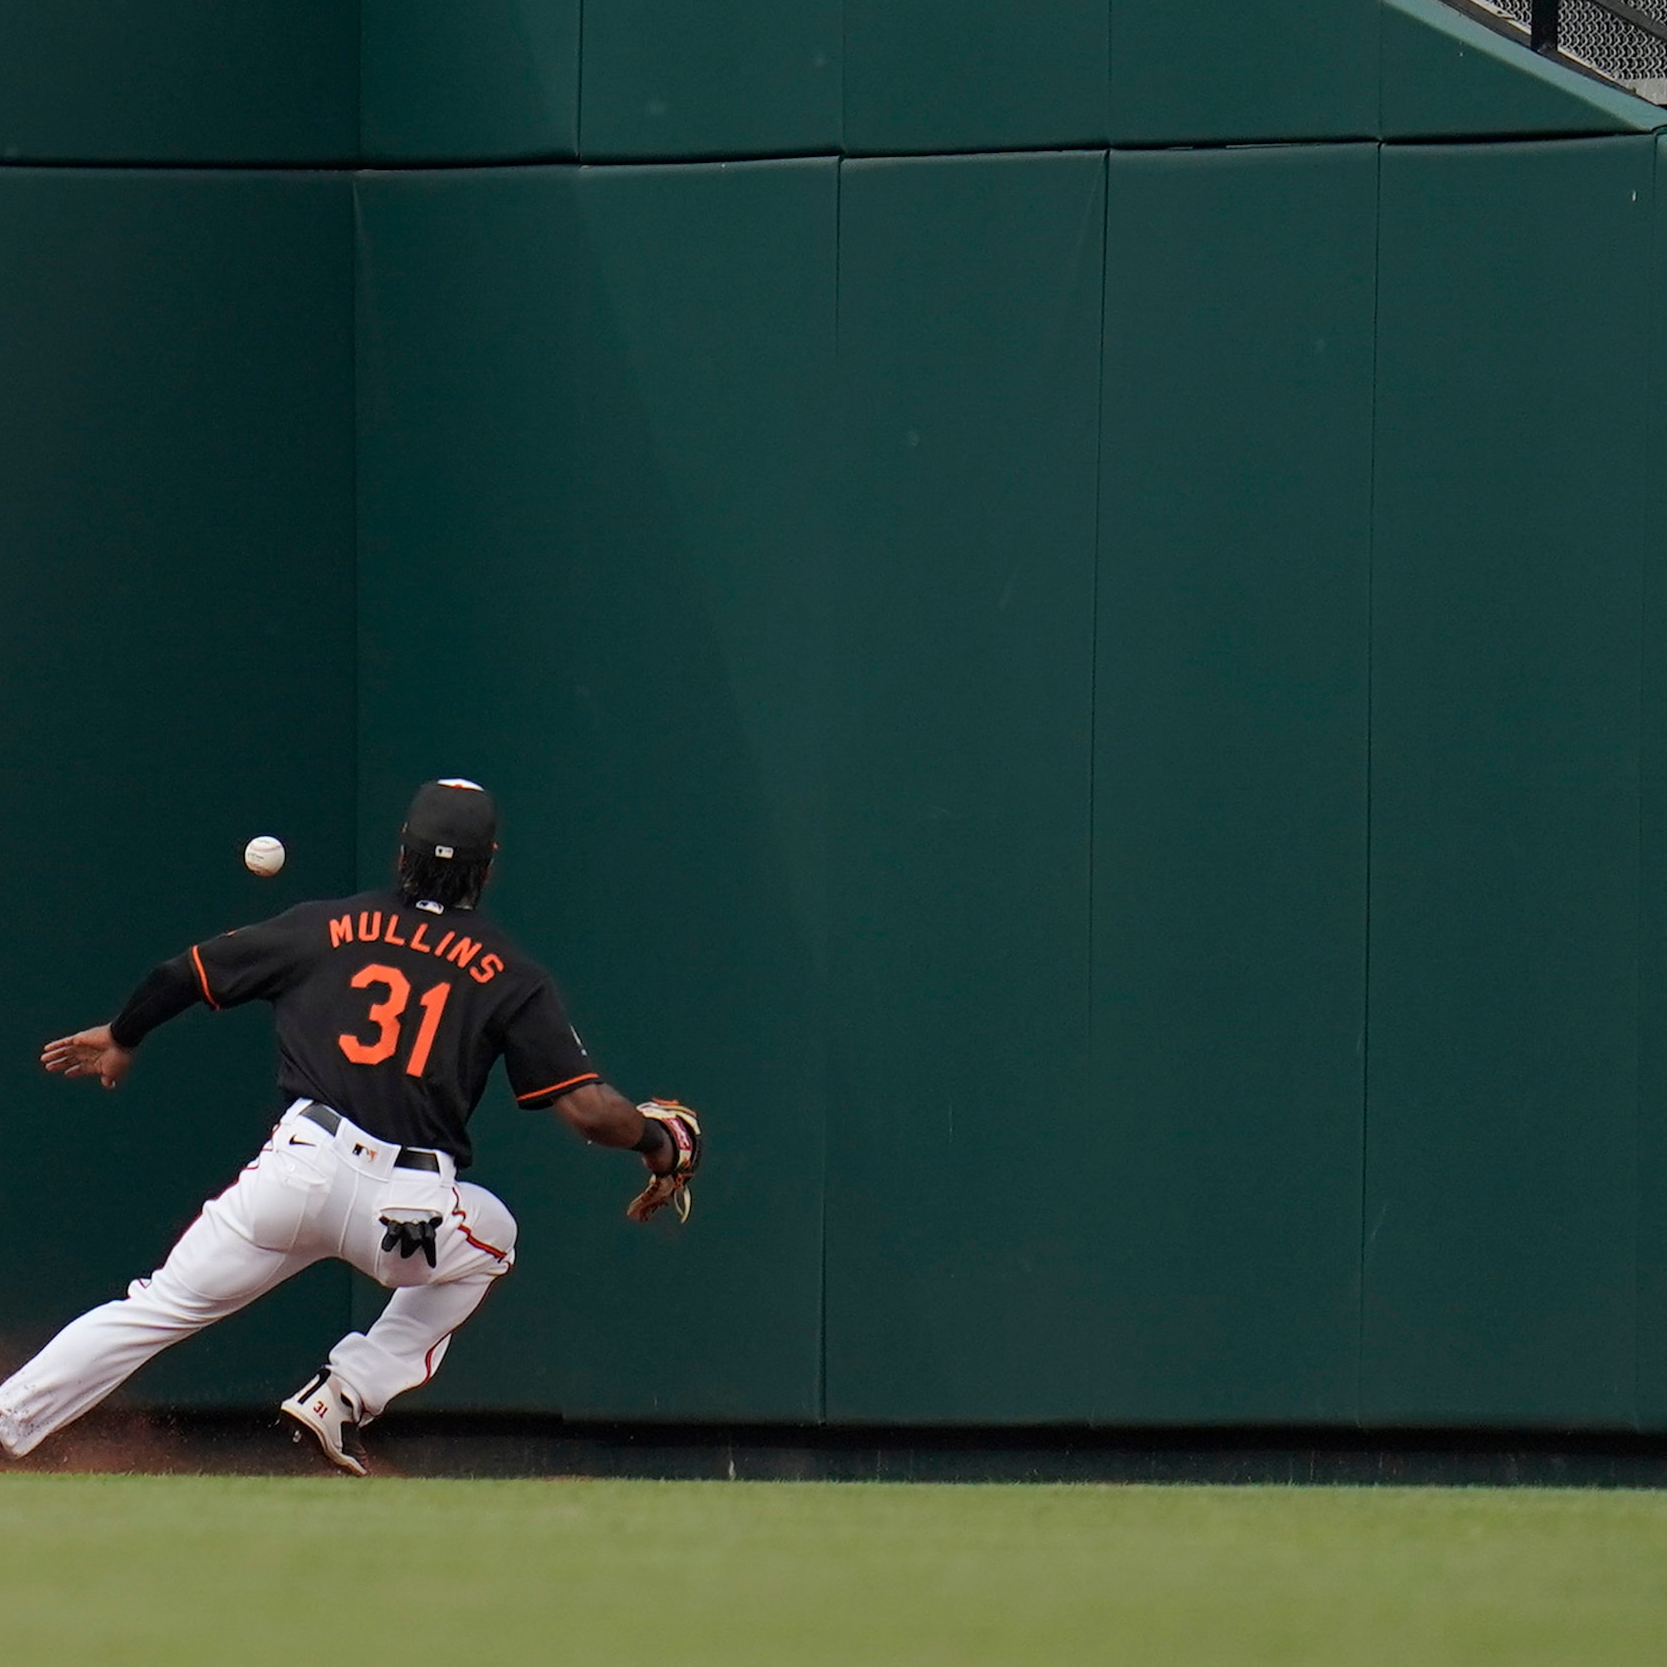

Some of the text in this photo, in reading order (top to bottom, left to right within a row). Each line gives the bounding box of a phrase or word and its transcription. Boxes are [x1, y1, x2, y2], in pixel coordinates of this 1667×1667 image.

[328, 911, 505, 984] MULLINS
[338, 963, 451, 1078] 31
[312, 1400, 329, 1420] 31
